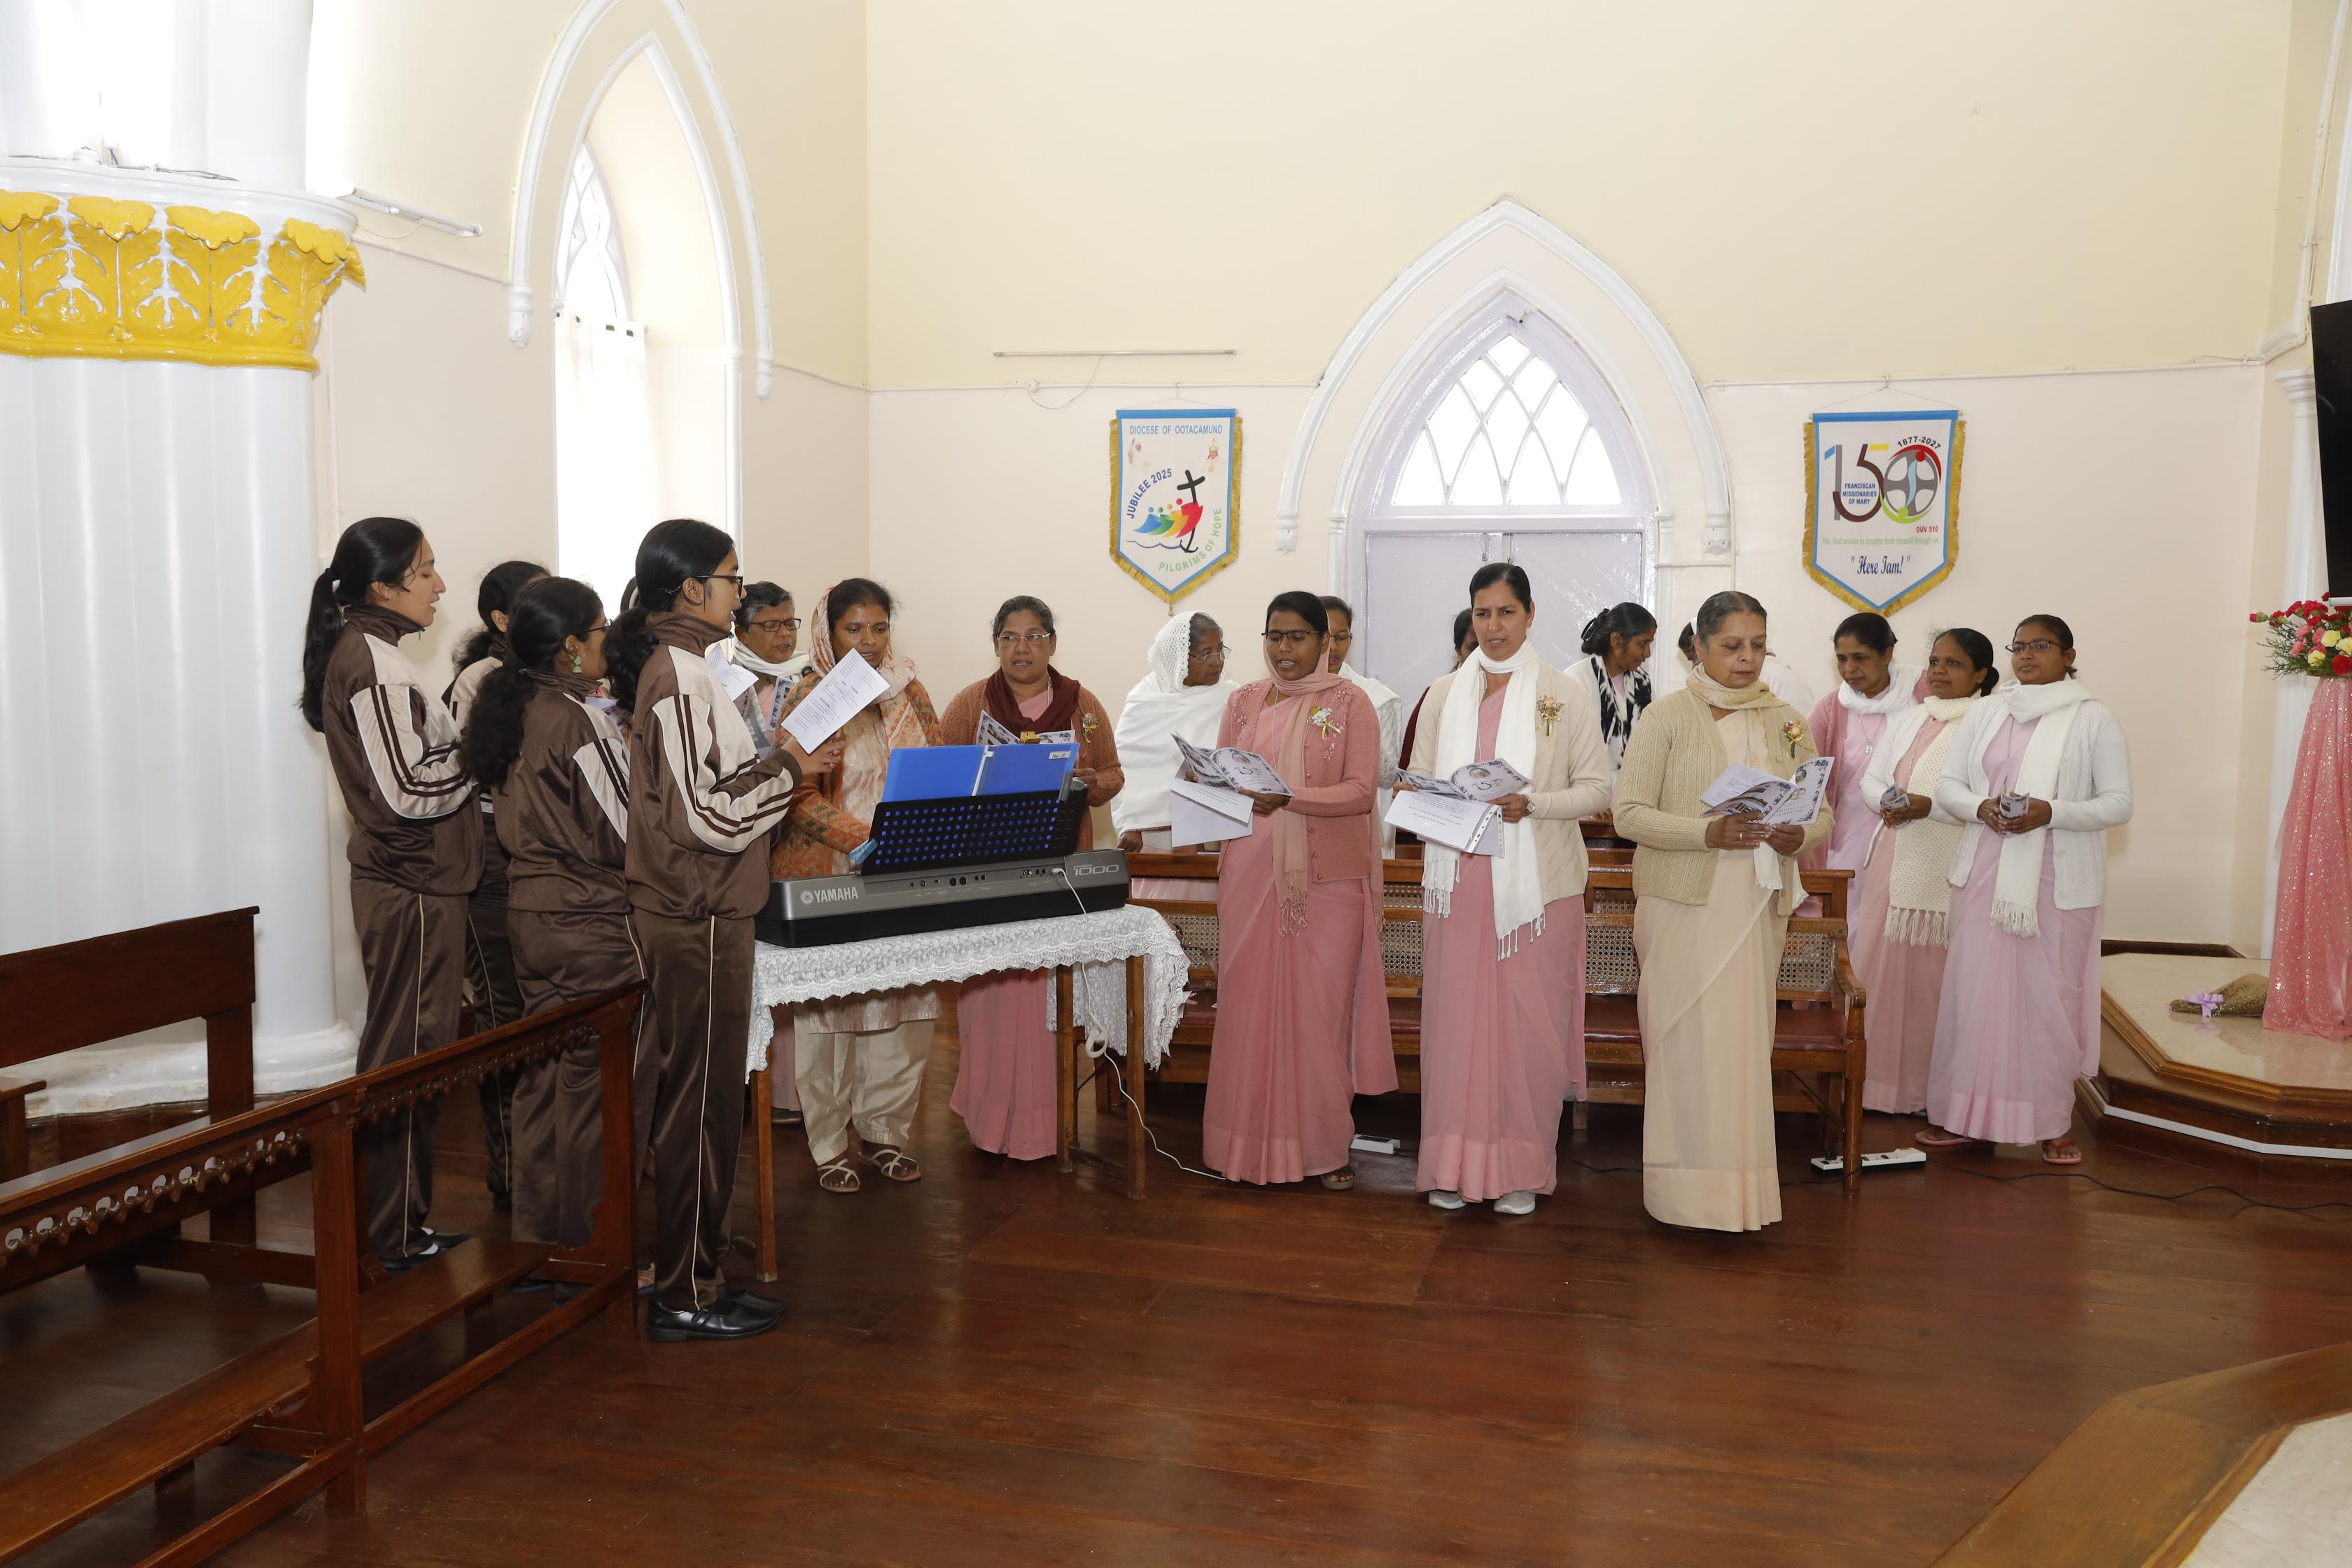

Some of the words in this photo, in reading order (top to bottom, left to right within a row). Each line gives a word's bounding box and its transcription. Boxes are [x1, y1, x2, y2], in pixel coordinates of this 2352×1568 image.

[1130, 425, 1159, 435] DIOCESE
[1162, 425, 1171, 434] OF
[1175, 425, 1223, 434] OOTACAMUND
[1897, 435, 1941, 450] 1877-2027
[1126, 479, 1152, 519] JUBILEE
[1150, 468, 1172, 484] 2025
[1158, 552, 1206, 572] PILGRIMS
[1205, 538, 1216, 552] OF
[1213, 508, 1222, 536] HOPE
[1857, 555, 1878, 575] Here
[1073, 864, 1119, 876] 1000
[813, 886, 859, 903] YAMAHA
